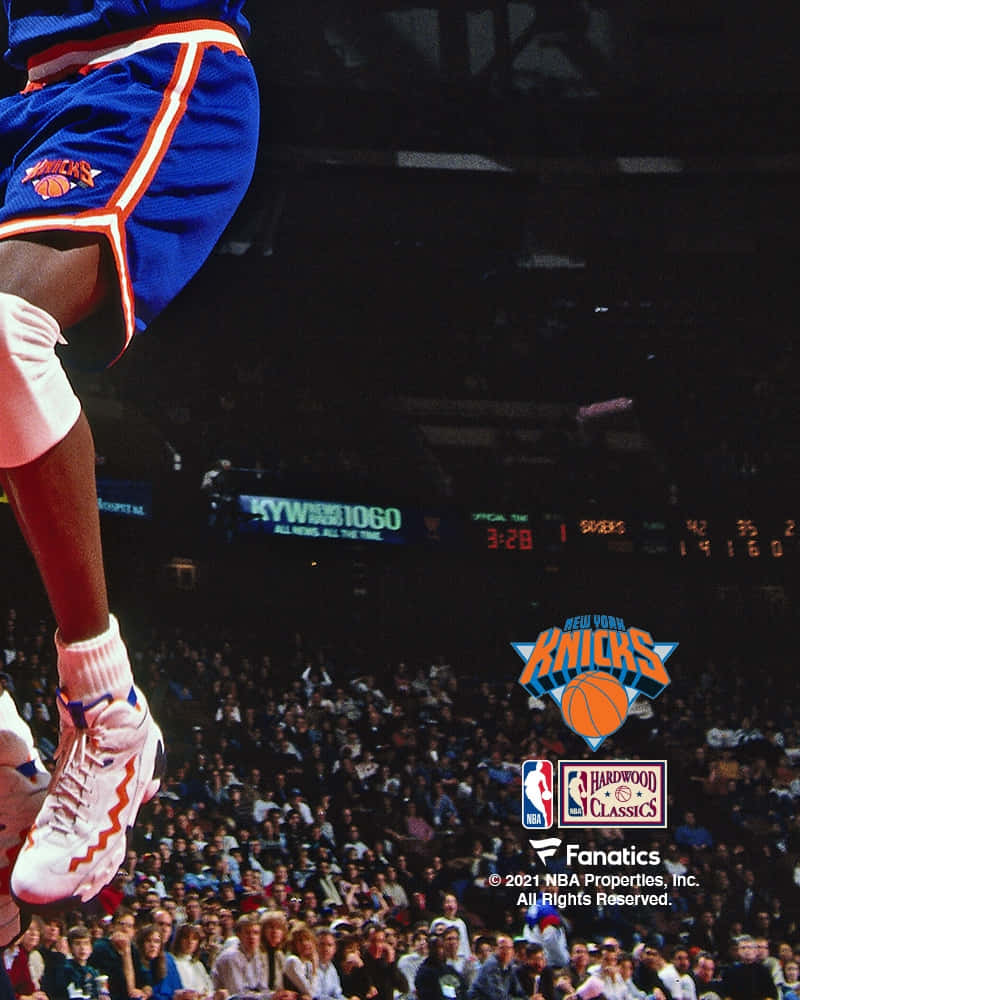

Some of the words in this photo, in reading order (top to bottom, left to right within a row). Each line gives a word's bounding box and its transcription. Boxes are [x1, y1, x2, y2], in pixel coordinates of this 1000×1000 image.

[250, 499, 308, 524] KYW
[343, 504, 402, 531] 1060
[487, 527, 533, 550] 3:28
